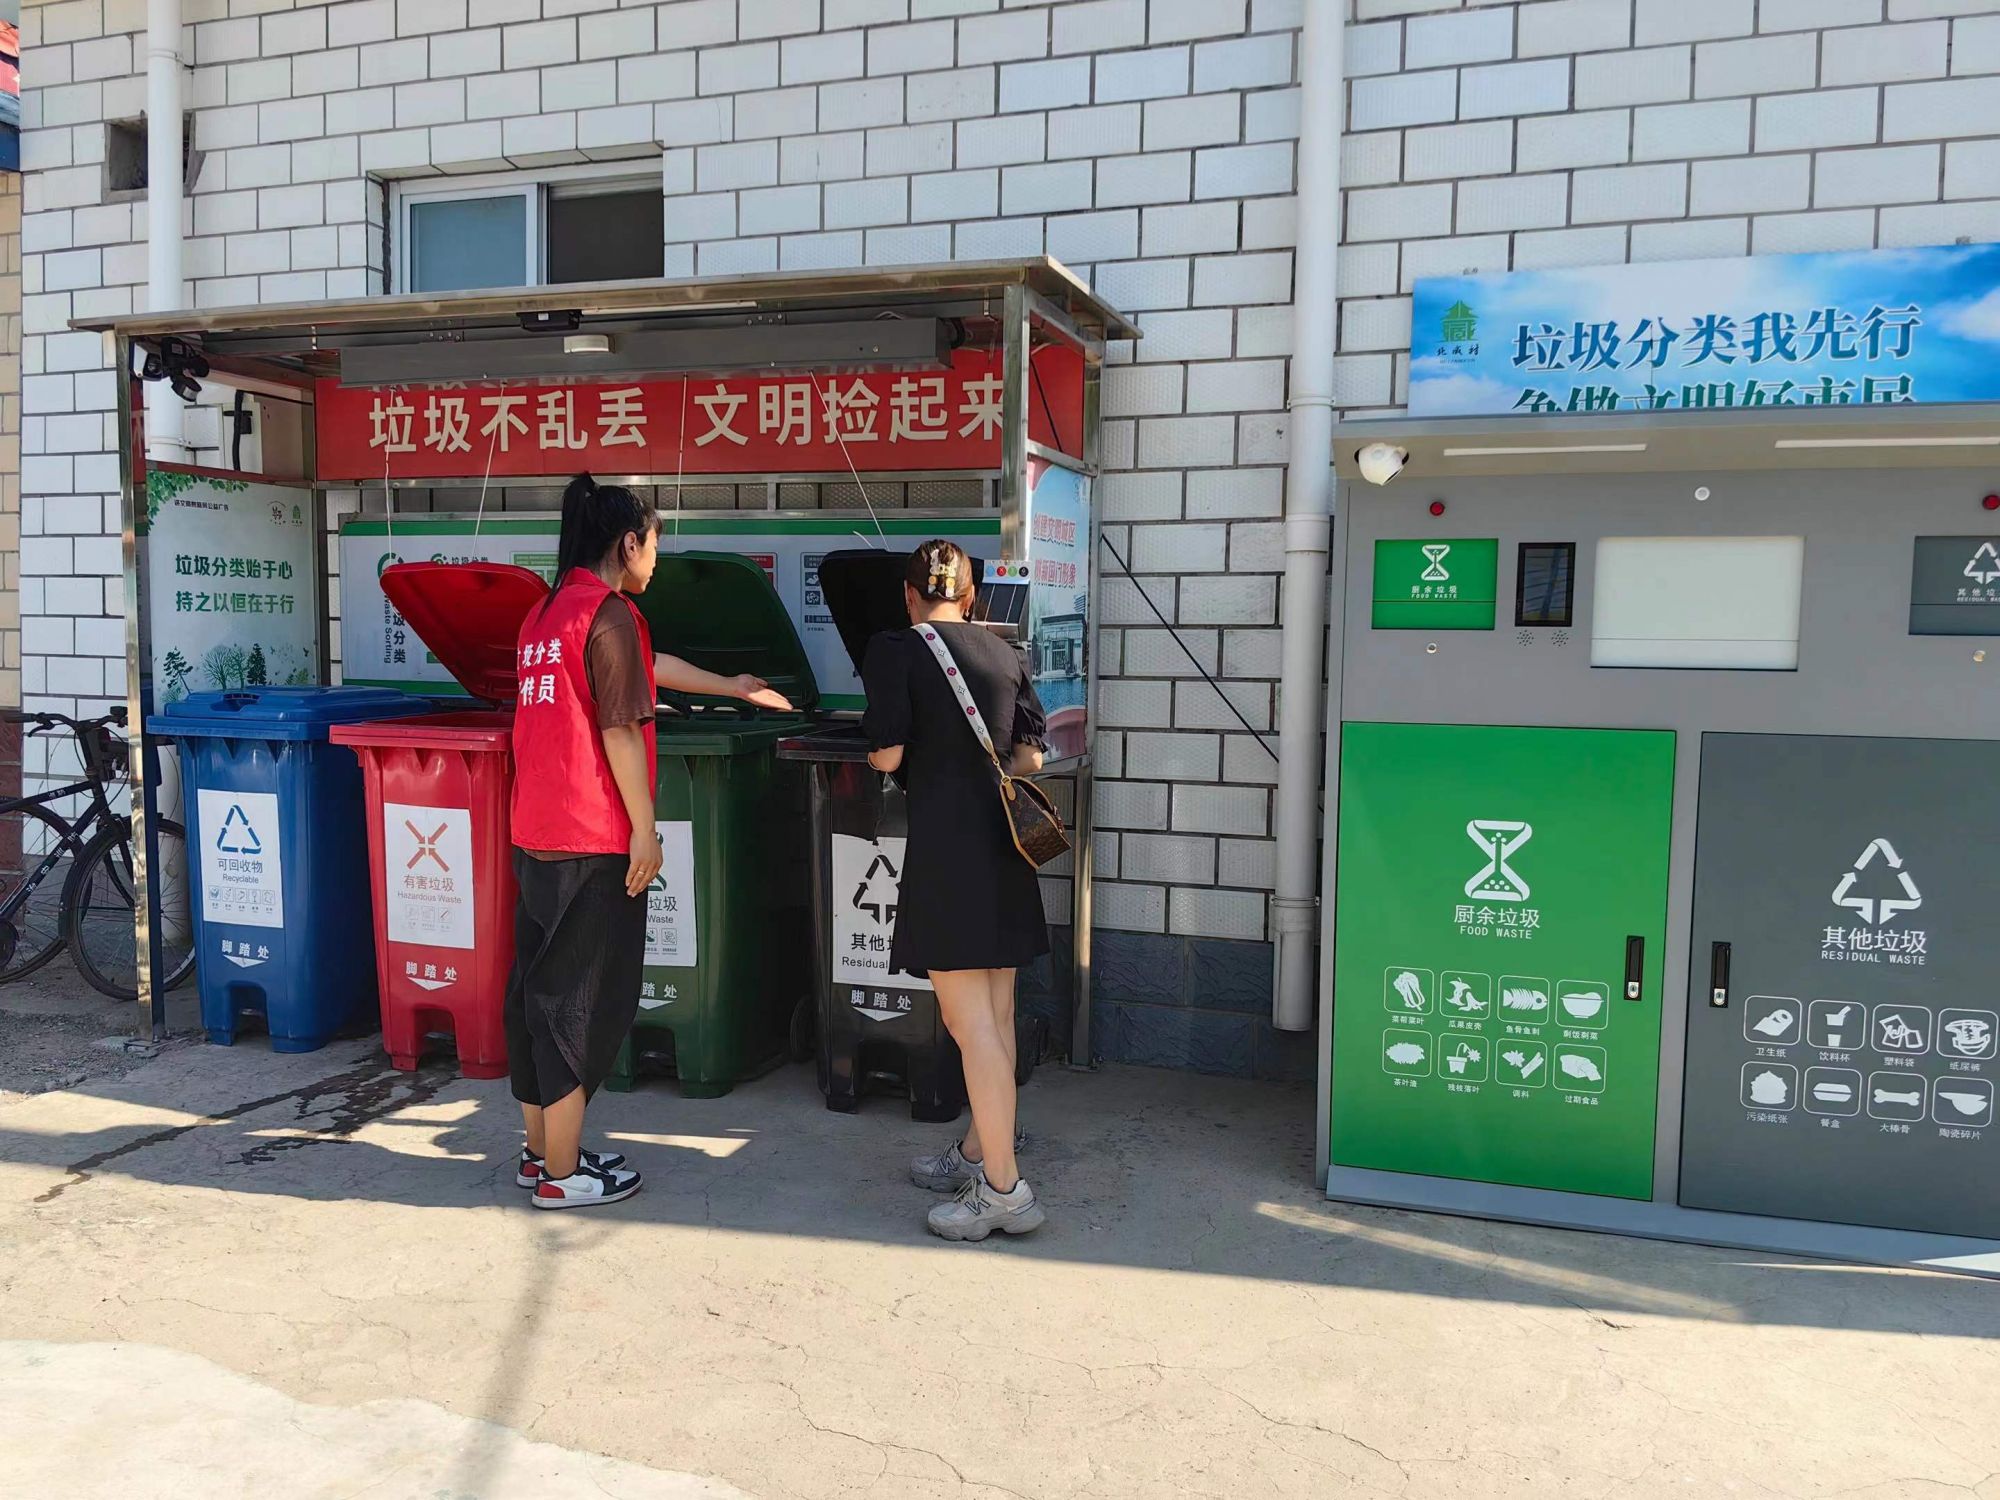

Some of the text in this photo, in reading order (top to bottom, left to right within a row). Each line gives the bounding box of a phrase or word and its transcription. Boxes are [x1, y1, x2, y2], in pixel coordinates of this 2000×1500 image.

[1511, 304, 1922, 373] 垃圾分类我先行
[368, 372, 1003, 454] 垃圾不乱丢 文明捡起来
[175, 554, 293, 580] 垃圾分类始于心
[175, 590, 295, 615] 持之以恒在于行
[384, 627, 393, 664] Sorting
[518, 638, 562, 669] 圾分类
[519, 674, 556, 706] 传员
[218, 859, 263, 874] 可回收物
[222, 873, 260, 884] Recyclable
[403, 875, 455, 892] 有害垃圾
[397, 890, 462, 904] Hazardous Waste
[649, 896, 678, 912] 垃圾
[647, 914, 674, 924] Waste
[1454, 904, 1540, 929] 厨余垃圾
[1460, 926, 1532, 940] FOOD WASTE
[1821, 926, 1927, 954] 其他垃圾
[222, 939, 270, 959] 脚踏处
[841, 956, 888, 969] Residual
[1821, 950, 1926, 966] RESIDUAL WASTE
[405, 961, 457, 981] 脚踏处
[850, 989, 912, 1011] 脚踏处
[1448, 1020, 1482, 1031] 瓜果皮壳
[1506, 1025, 1540, 1036] 鱼骨鱼刺
[1562, 1030, 1599, 1041] 剩饭剩菜
[1755, 1047, 1787, 1059] 卫生纸
[1818, 1051, 1851, 1063] 饮料杯
[1883, 1056, 1916, 1068] 塑料袋
[1949, 1062, 1981, 1073] 纸尿裤
[1393, 1078, 1418, 1088] 茶叶渣
[1447, 1083, 1480, 1094] 残枝落叶
[1512, 1089, 1530, 1099] 调料
[1564, 1094, 1600, 1106] 过期食品
[1746, 1112, 1788, 1125] 污染纸张
[1820, 1118, 1841, 1129] 餐盒
[1879, 1123, 1911, 1134] 大棒骨
[1938, 1127, 1982, 1141] 陶瓷碎片
